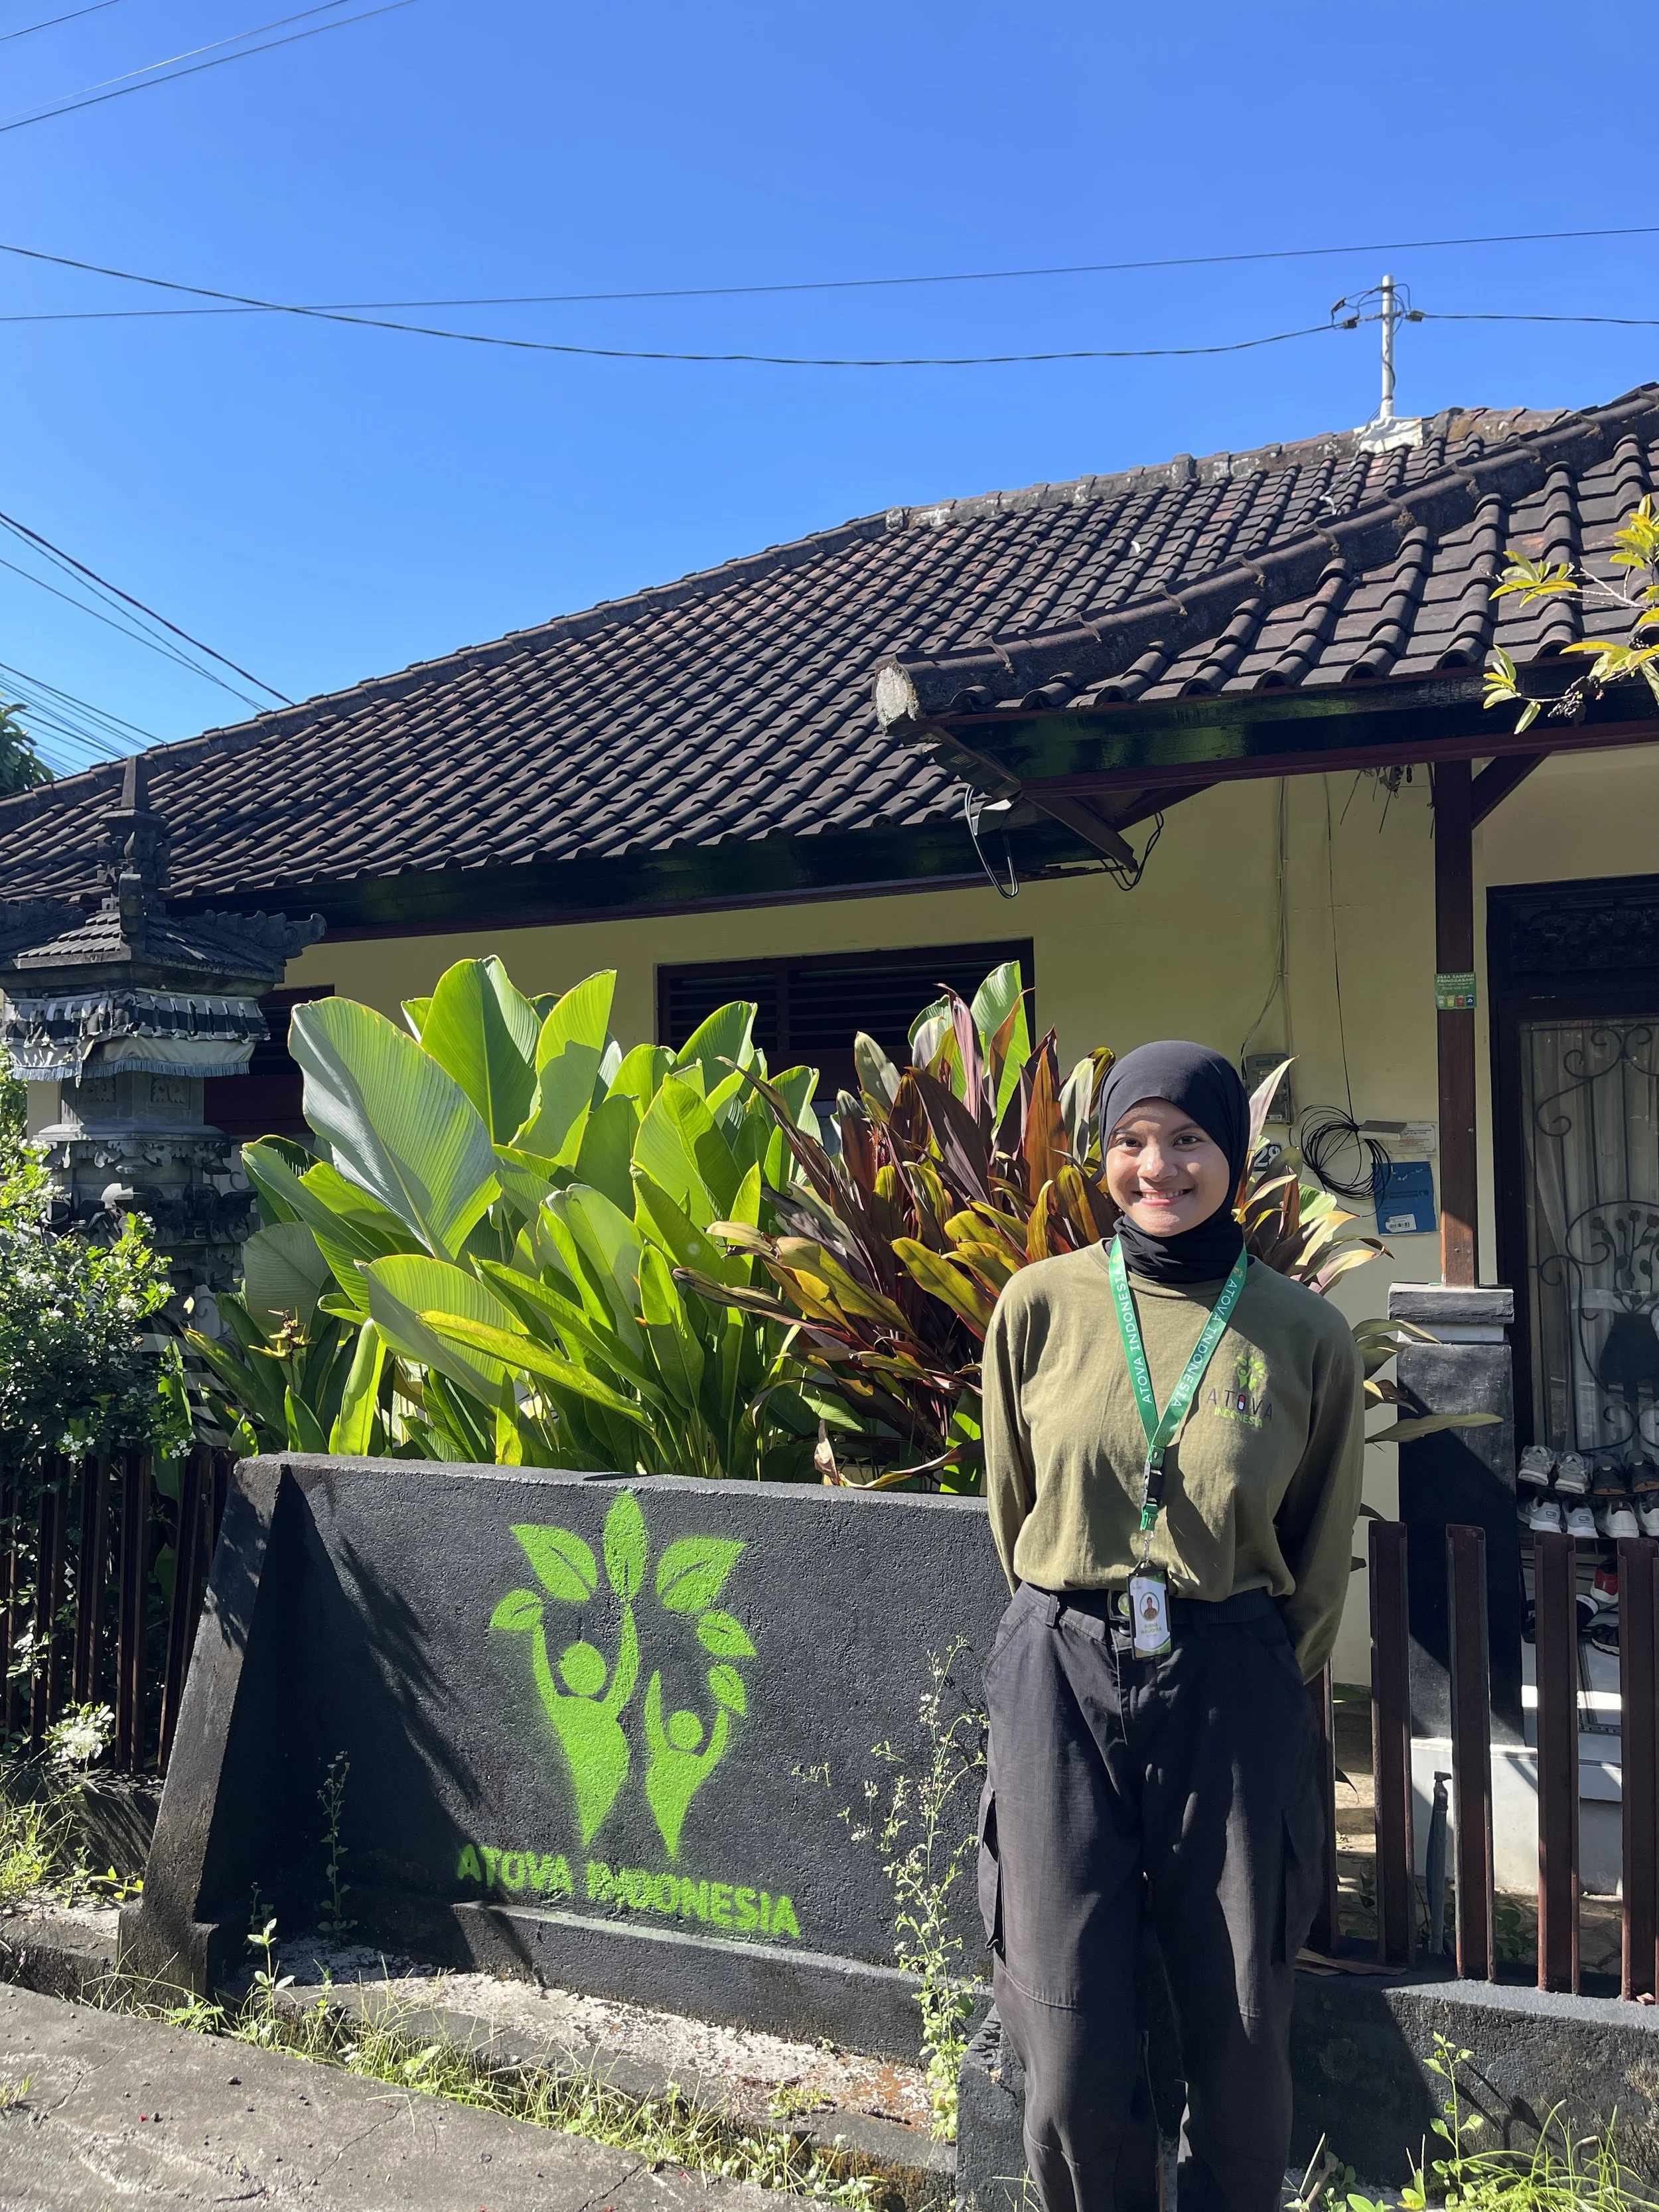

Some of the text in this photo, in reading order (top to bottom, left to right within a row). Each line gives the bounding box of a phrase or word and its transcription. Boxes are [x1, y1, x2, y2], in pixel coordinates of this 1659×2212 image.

[1115, 1268, 1152, 1403] ATOVA INDONESIA
[1171, 1279, 1238, 1407] ATOVA INDONESIA
[1214, 1406, 1263, 1428] INDONESIA
[457, 1843, 799, 1938] ATOVA INDONESIA
